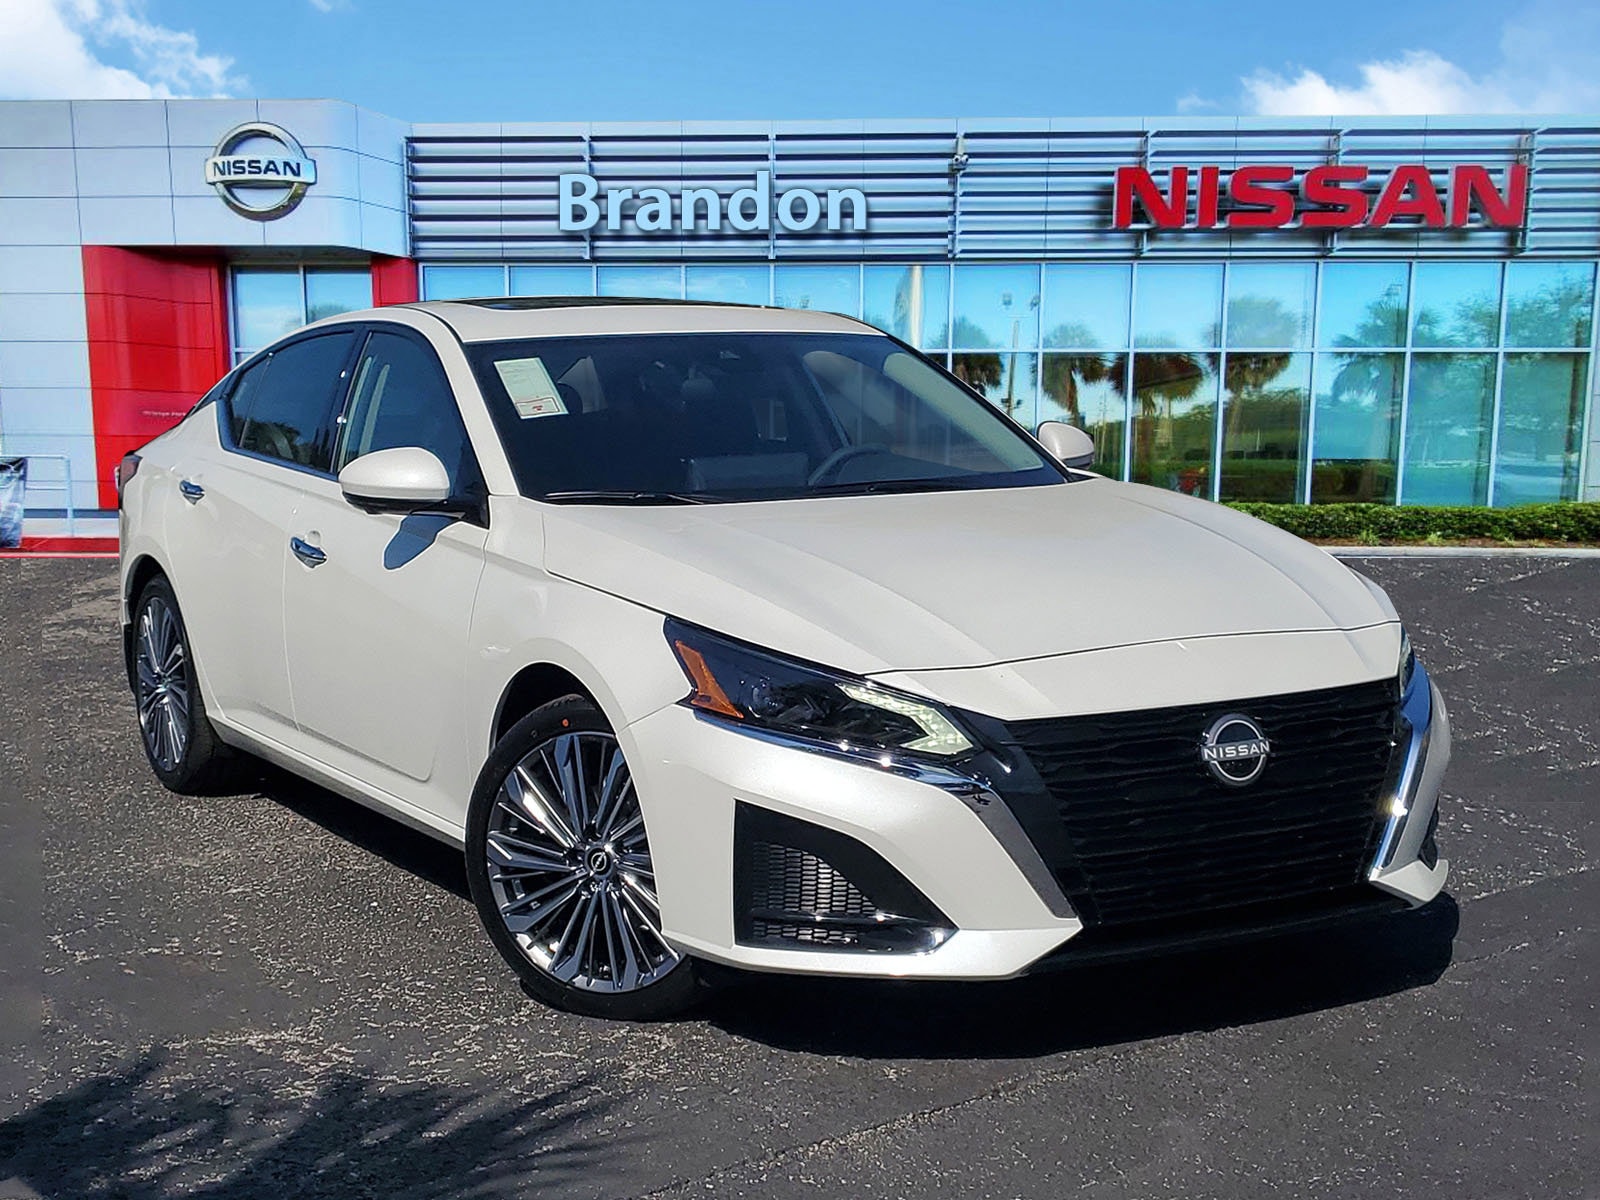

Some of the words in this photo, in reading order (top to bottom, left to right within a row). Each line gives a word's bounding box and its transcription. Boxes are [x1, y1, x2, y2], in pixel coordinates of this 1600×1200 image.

[213, 160, 301, 177] NISSAN
[559, 170, 867, 231] Brandon
[1113, 165, 1528, 228] NISSAN
[1203, 740, 1270, 760] NISSAN
